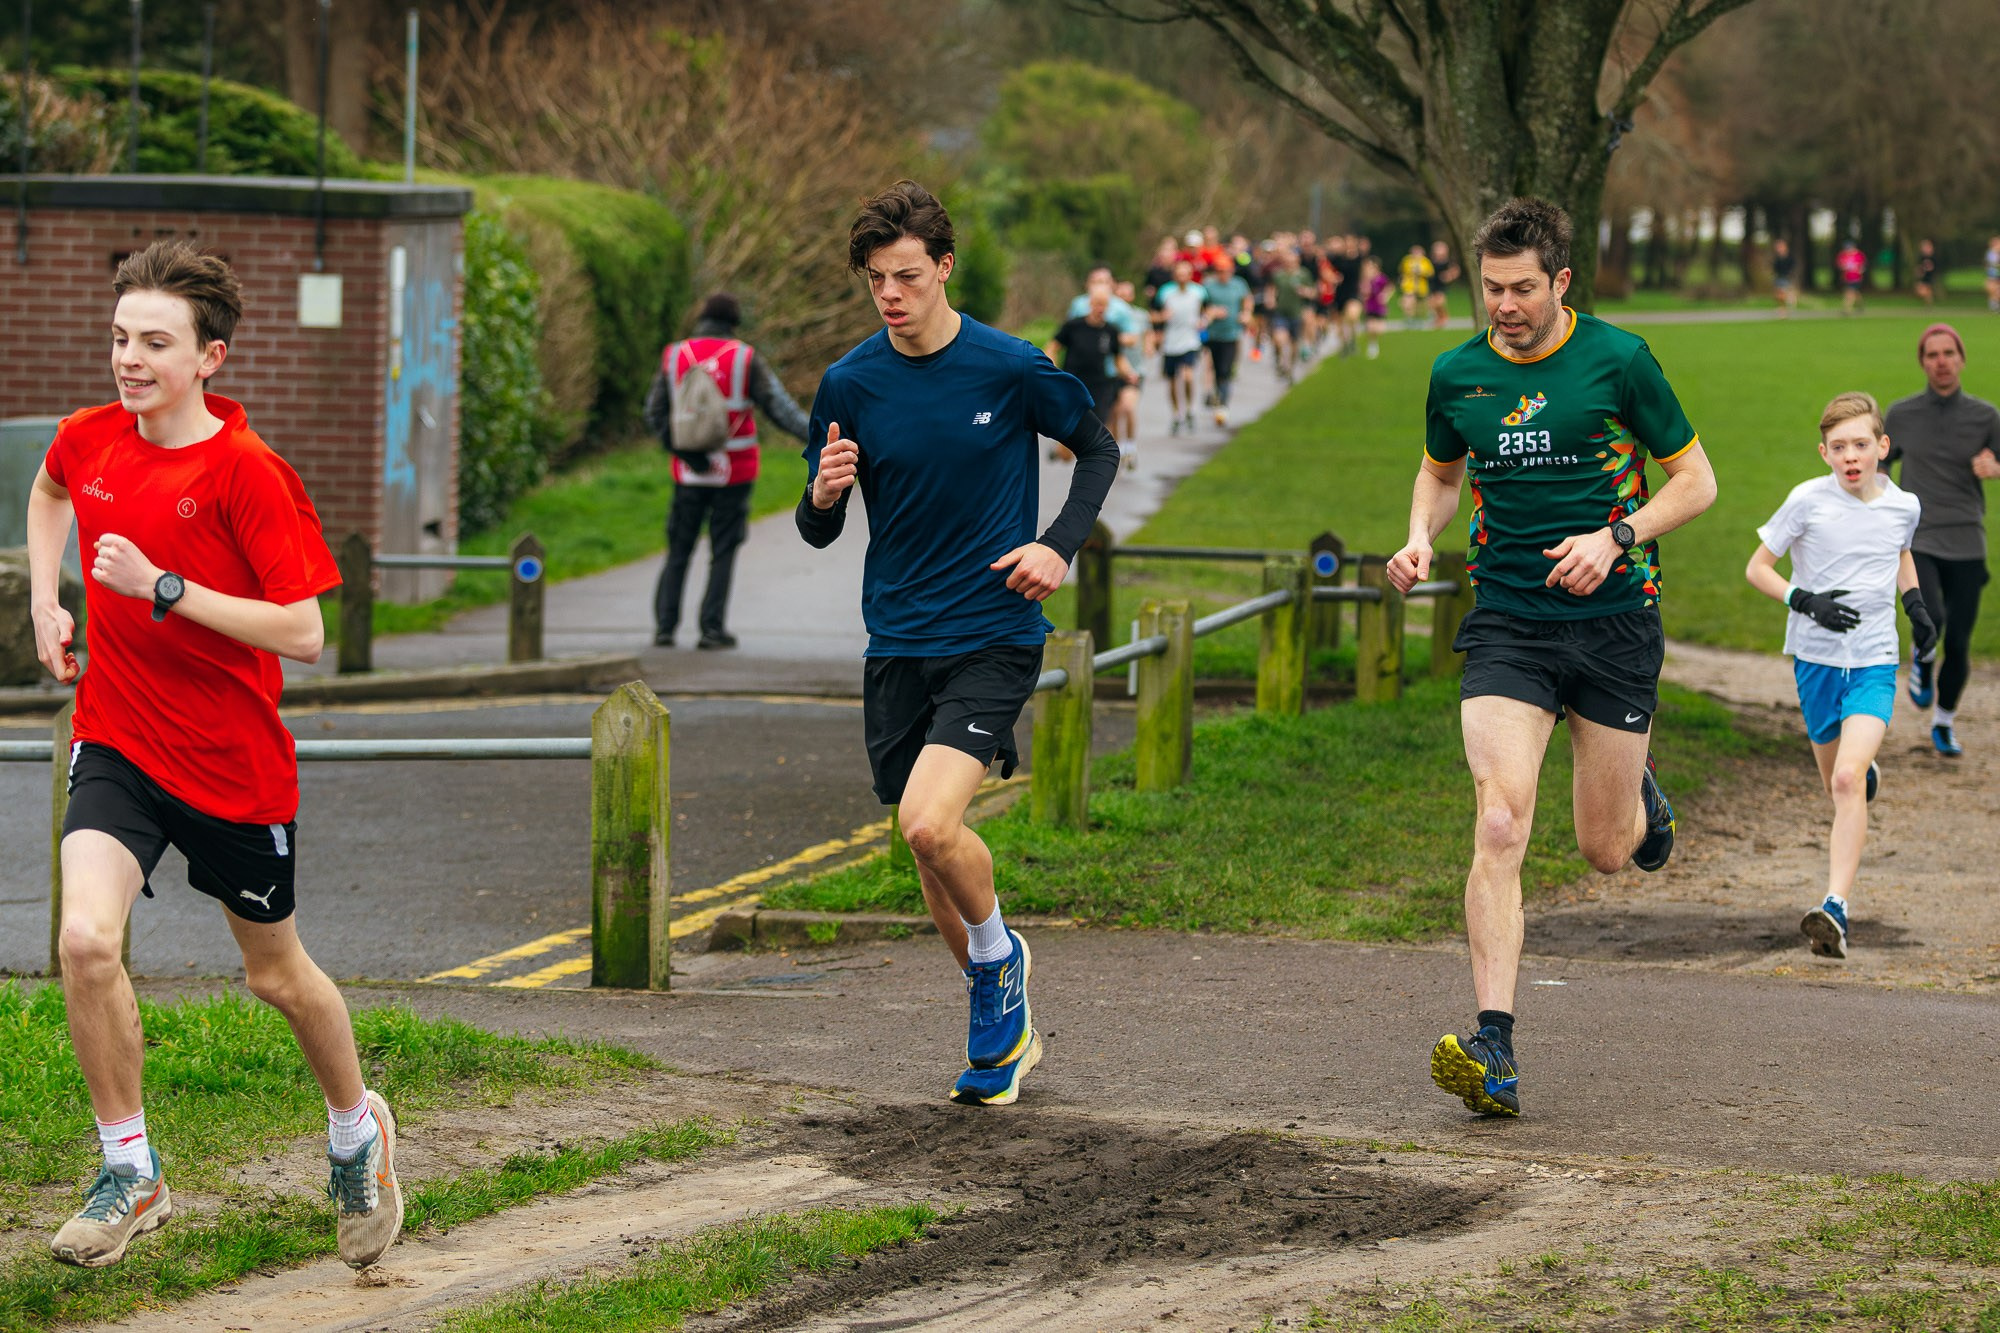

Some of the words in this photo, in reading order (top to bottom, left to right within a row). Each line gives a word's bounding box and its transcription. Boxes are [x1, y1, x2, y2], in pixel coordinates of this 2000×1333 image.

[1498, 430, 1551, 456] 2353
[1521, 454, 1578, 467] RUNNERS
[82, 477, 114, 503] parkrun
